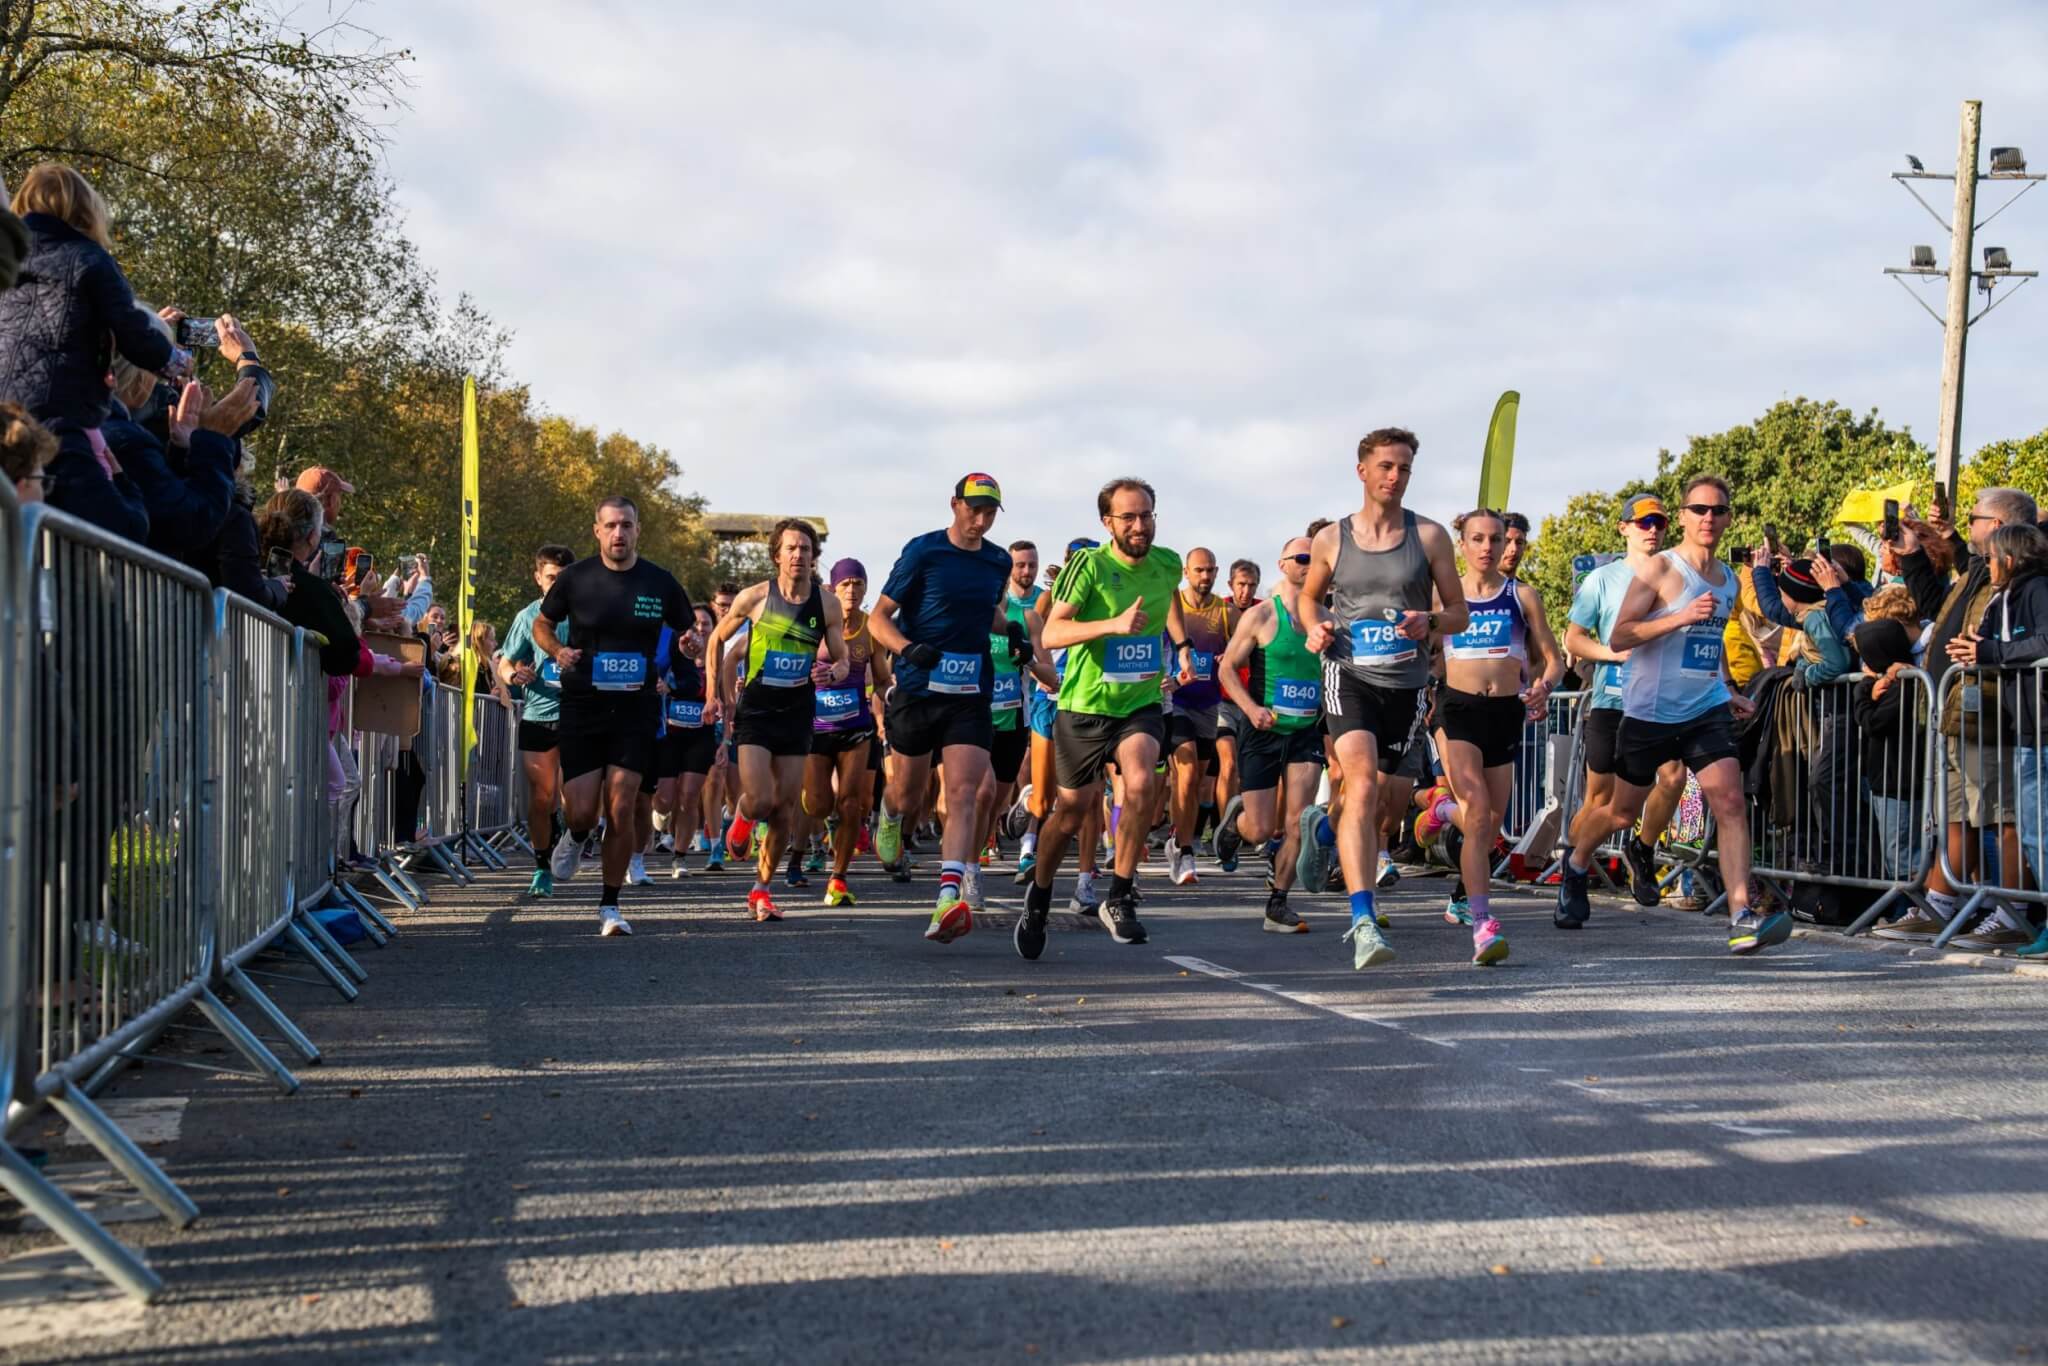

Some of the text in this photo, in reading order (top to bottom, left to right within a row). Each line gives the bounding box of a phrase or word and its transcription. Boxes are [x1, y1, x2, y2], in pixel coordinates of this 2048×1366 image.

[634, 609, 650, 618] Long
[1461, 620, 1502, 637] 447
[1466, 636, 1496, 645] LAUREN
[1116, 643, 1153, 660] 1051
[1693, 643, 1719, 659] 1410
[602, 658, 640, 672] 1828
[773, 656, 806, 671] 1017
[940, 658, 976, 674] 1074
[1281, 684, 1316, 699] 1840
[823, 694, 853, 708] 1835
[675, 704, 701, 716] 1330
